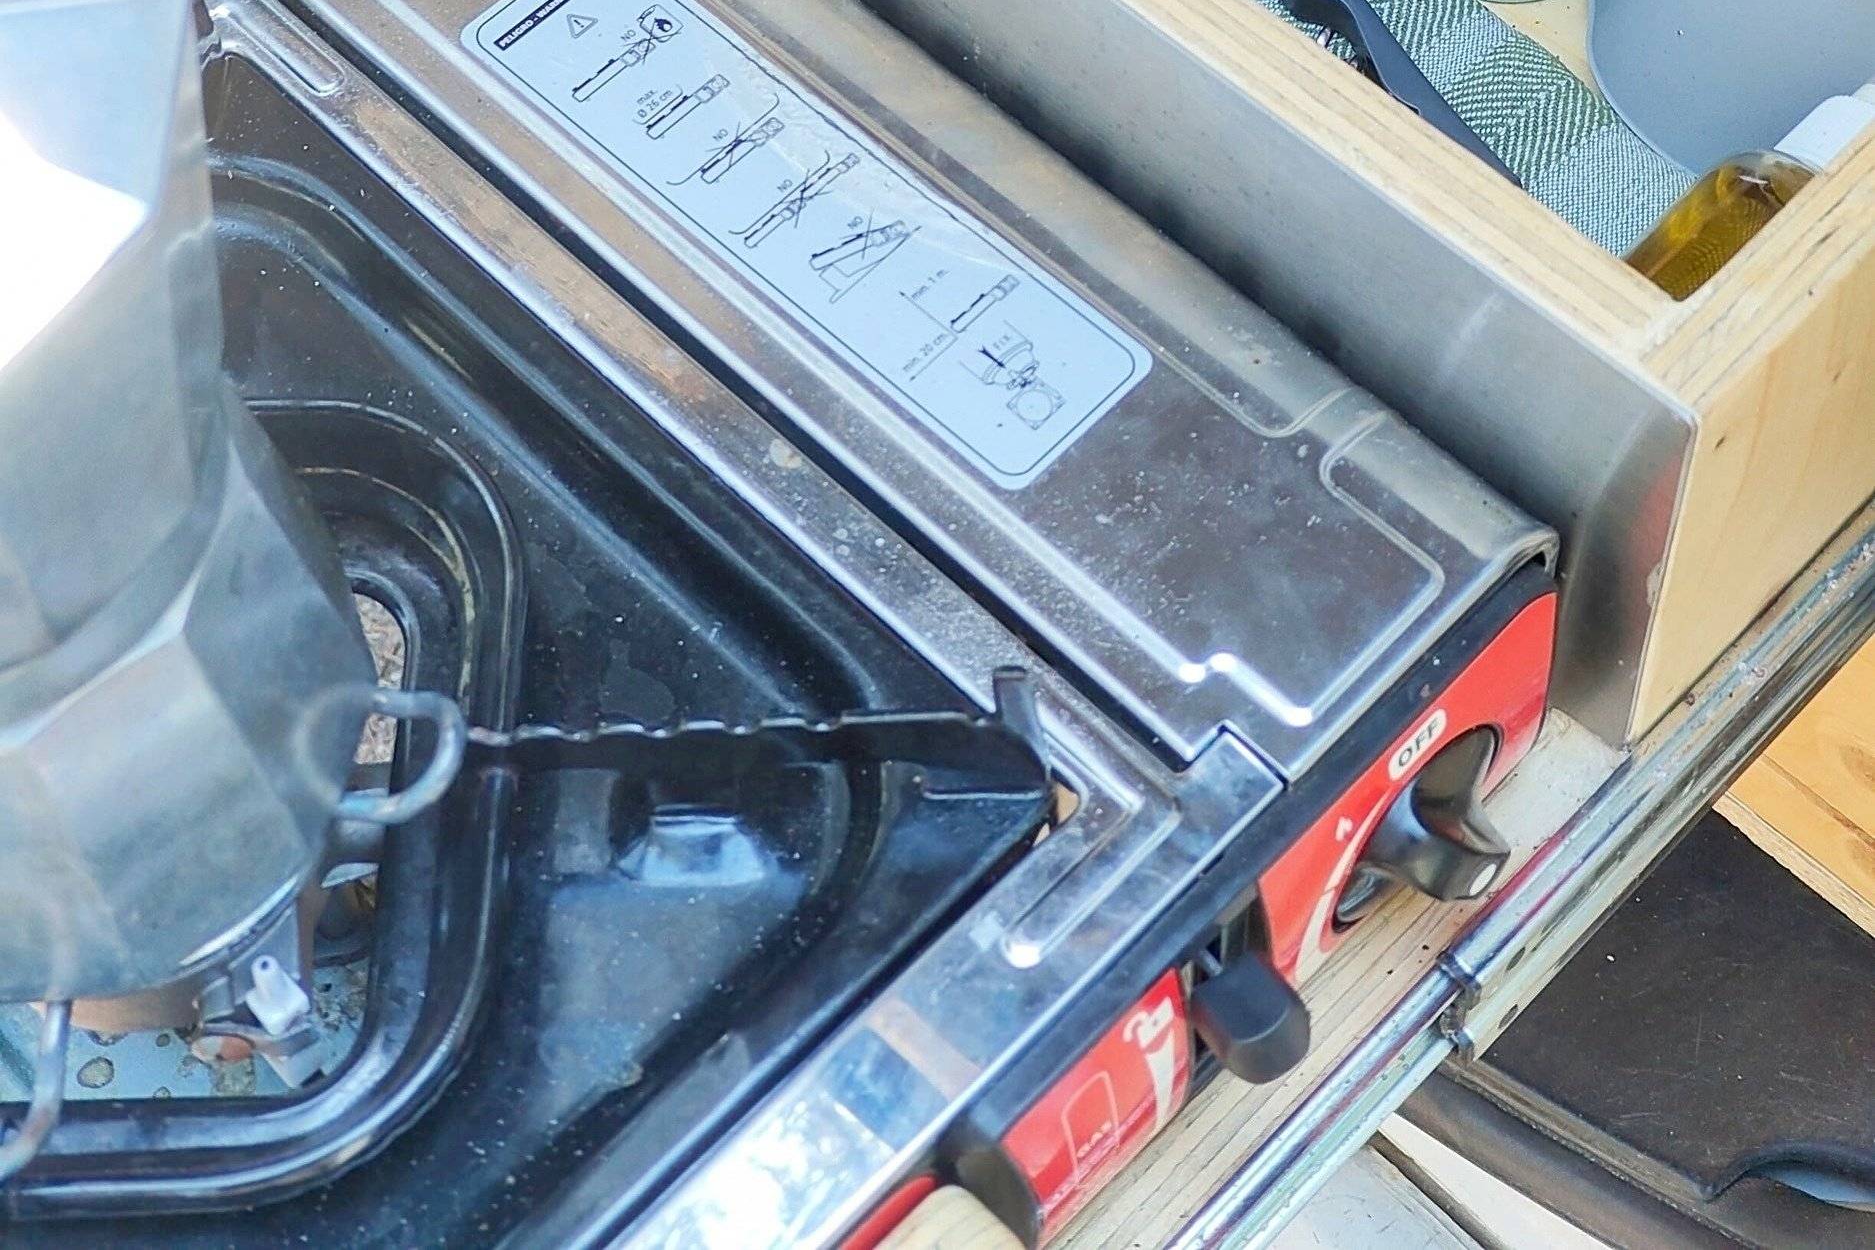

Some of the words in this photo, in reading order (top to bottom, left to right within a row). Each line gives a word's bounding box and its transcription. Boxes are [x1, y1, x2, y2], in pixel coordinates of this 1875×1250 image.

[621, 29, 637, 42] NO
[712, 128, 729, 142] NO
[777, 178, 793, 193] NO
[847, 215, 864, 230] NO
[1398, 718, 1439, 767] OFF
